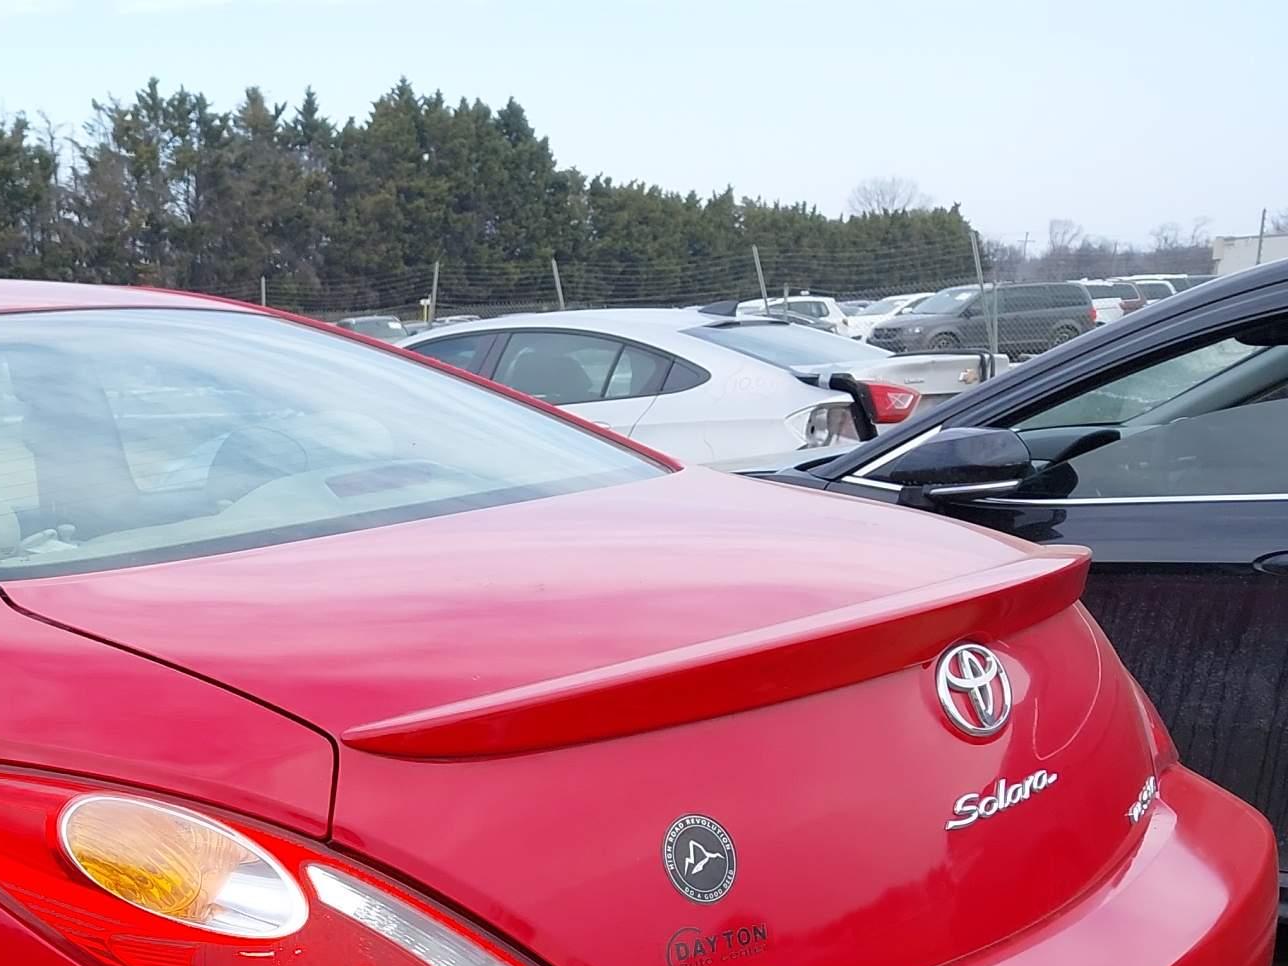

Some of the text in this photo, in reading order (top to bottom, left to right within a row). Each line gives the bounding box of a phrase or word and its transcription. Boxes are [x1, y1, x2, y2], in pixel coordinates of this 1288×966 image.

[945, 769, 1058, 831] Solara
[666, 818, 732, 870] HIGH ROAD REVOLUTION
[684, 886, 695, 896] DO
[704, 888, 723, 900] GOOD
[674, 922, 768, 961] DAYTON
